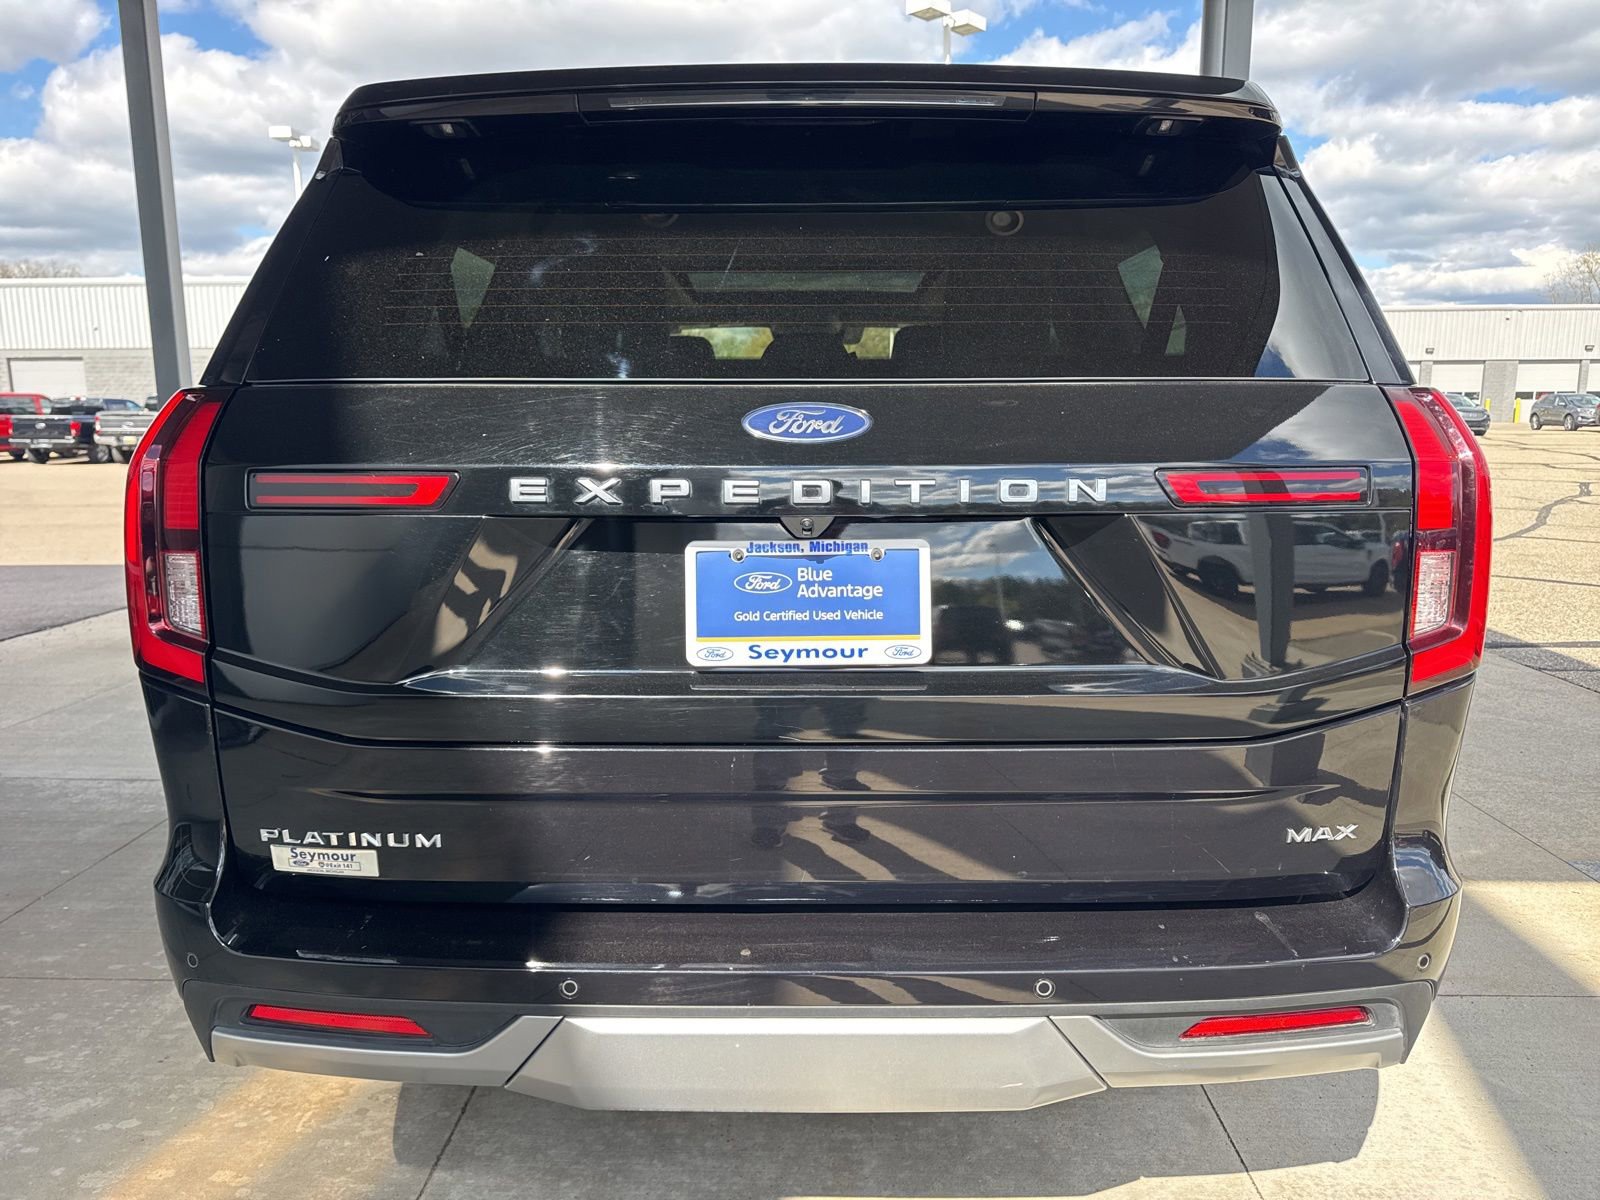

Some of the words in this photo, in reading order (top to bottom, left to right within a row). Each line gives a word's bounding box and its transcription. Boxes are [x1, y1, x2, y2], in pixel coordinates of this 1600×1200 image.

[768, 409, 843, 434] Ford
[509, 478, 1107, 505] EXPEDITION
[746, 542, 805, 554] Jackson,
[809, 541, 869, 555] Michigan
[797, 567, 833, 582] Blue
[744, 575, 781, 592] Ford
[797, 583, 883, 600] Advantage
[734, 611, 760, 622] Gold
[763, 610, 809, 621] Certified
[813, 609, 841, 620] Used
[844, 609, 884, 620] Vehicle
[704, 649, 726, 659] Ford
[748, 644, 869, 663] Seymour
[892, 646, 915, 657] Ford
[259, 828, 442, 848] PLATINUM
[1285, 823, 1359, 843] MAX
[290, 847, 356, 862] Seymour
